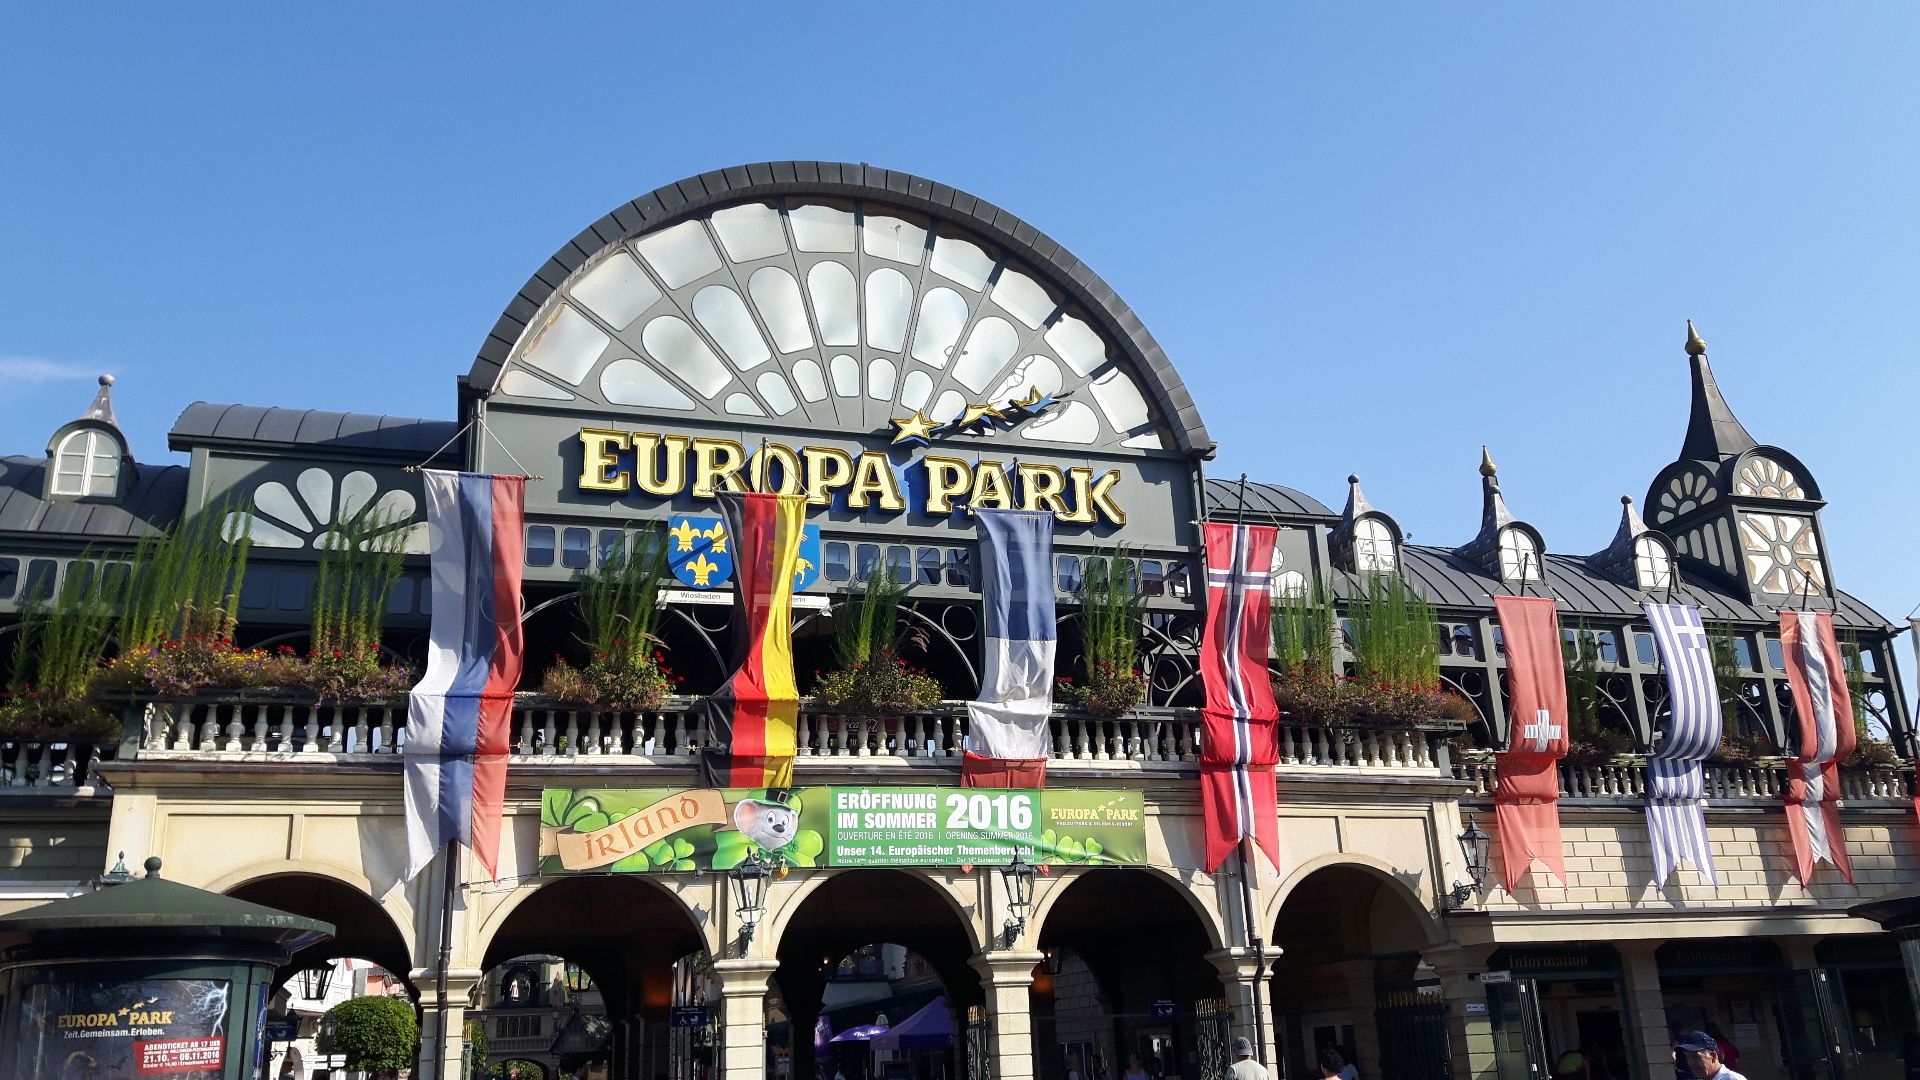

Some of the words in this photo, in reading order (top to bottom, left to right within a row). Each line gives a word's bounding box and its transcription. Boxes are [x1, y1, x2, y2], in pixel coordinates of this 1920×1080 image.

[579, 428, 905, 510] EUROPA
[924, 454, 1127, 525] PARK
[837, 789, 937, 810] ERÖFFNUNG
[945, 793, 1033, 830] 2016
[1050, 808, 1099, 820] EUROPA
[1105, 808, 1138, 820] PARK
[837, 812, 858, 829] IM
[864, 812, 937, 829] SOMMER
[837, 831, 883, 840] OUVERTURE
[885, 831, 896, 840] EN
[898, 829, 912, 840] ÉTÉ
[915, 831, 933, 840] 2016
[945, 831, 979, 840] OPENING
[980, 831, 1013, 840] SUMMER
[1015, 831, 1033, 840] 2016
[837, 845, 866, 856] Unser
[870, 845, 885, 856] 14.
[888, 844, 954, 857] Europäischer
[956, 845, 1035, 855] Themenbereich!
[58, 1013, 118, 1028] EUROPA
[129, 1011, 172, 1026] PARK
[64, 1028, 165, 1039] Zeit.Gemeinsam.Erleben.
[144, 1042, 188, 1051] ABENDTICKET
[143, 1055, 169, 1063] 21.10.
[180, 1050, 220, 1061] 06.11.2016
